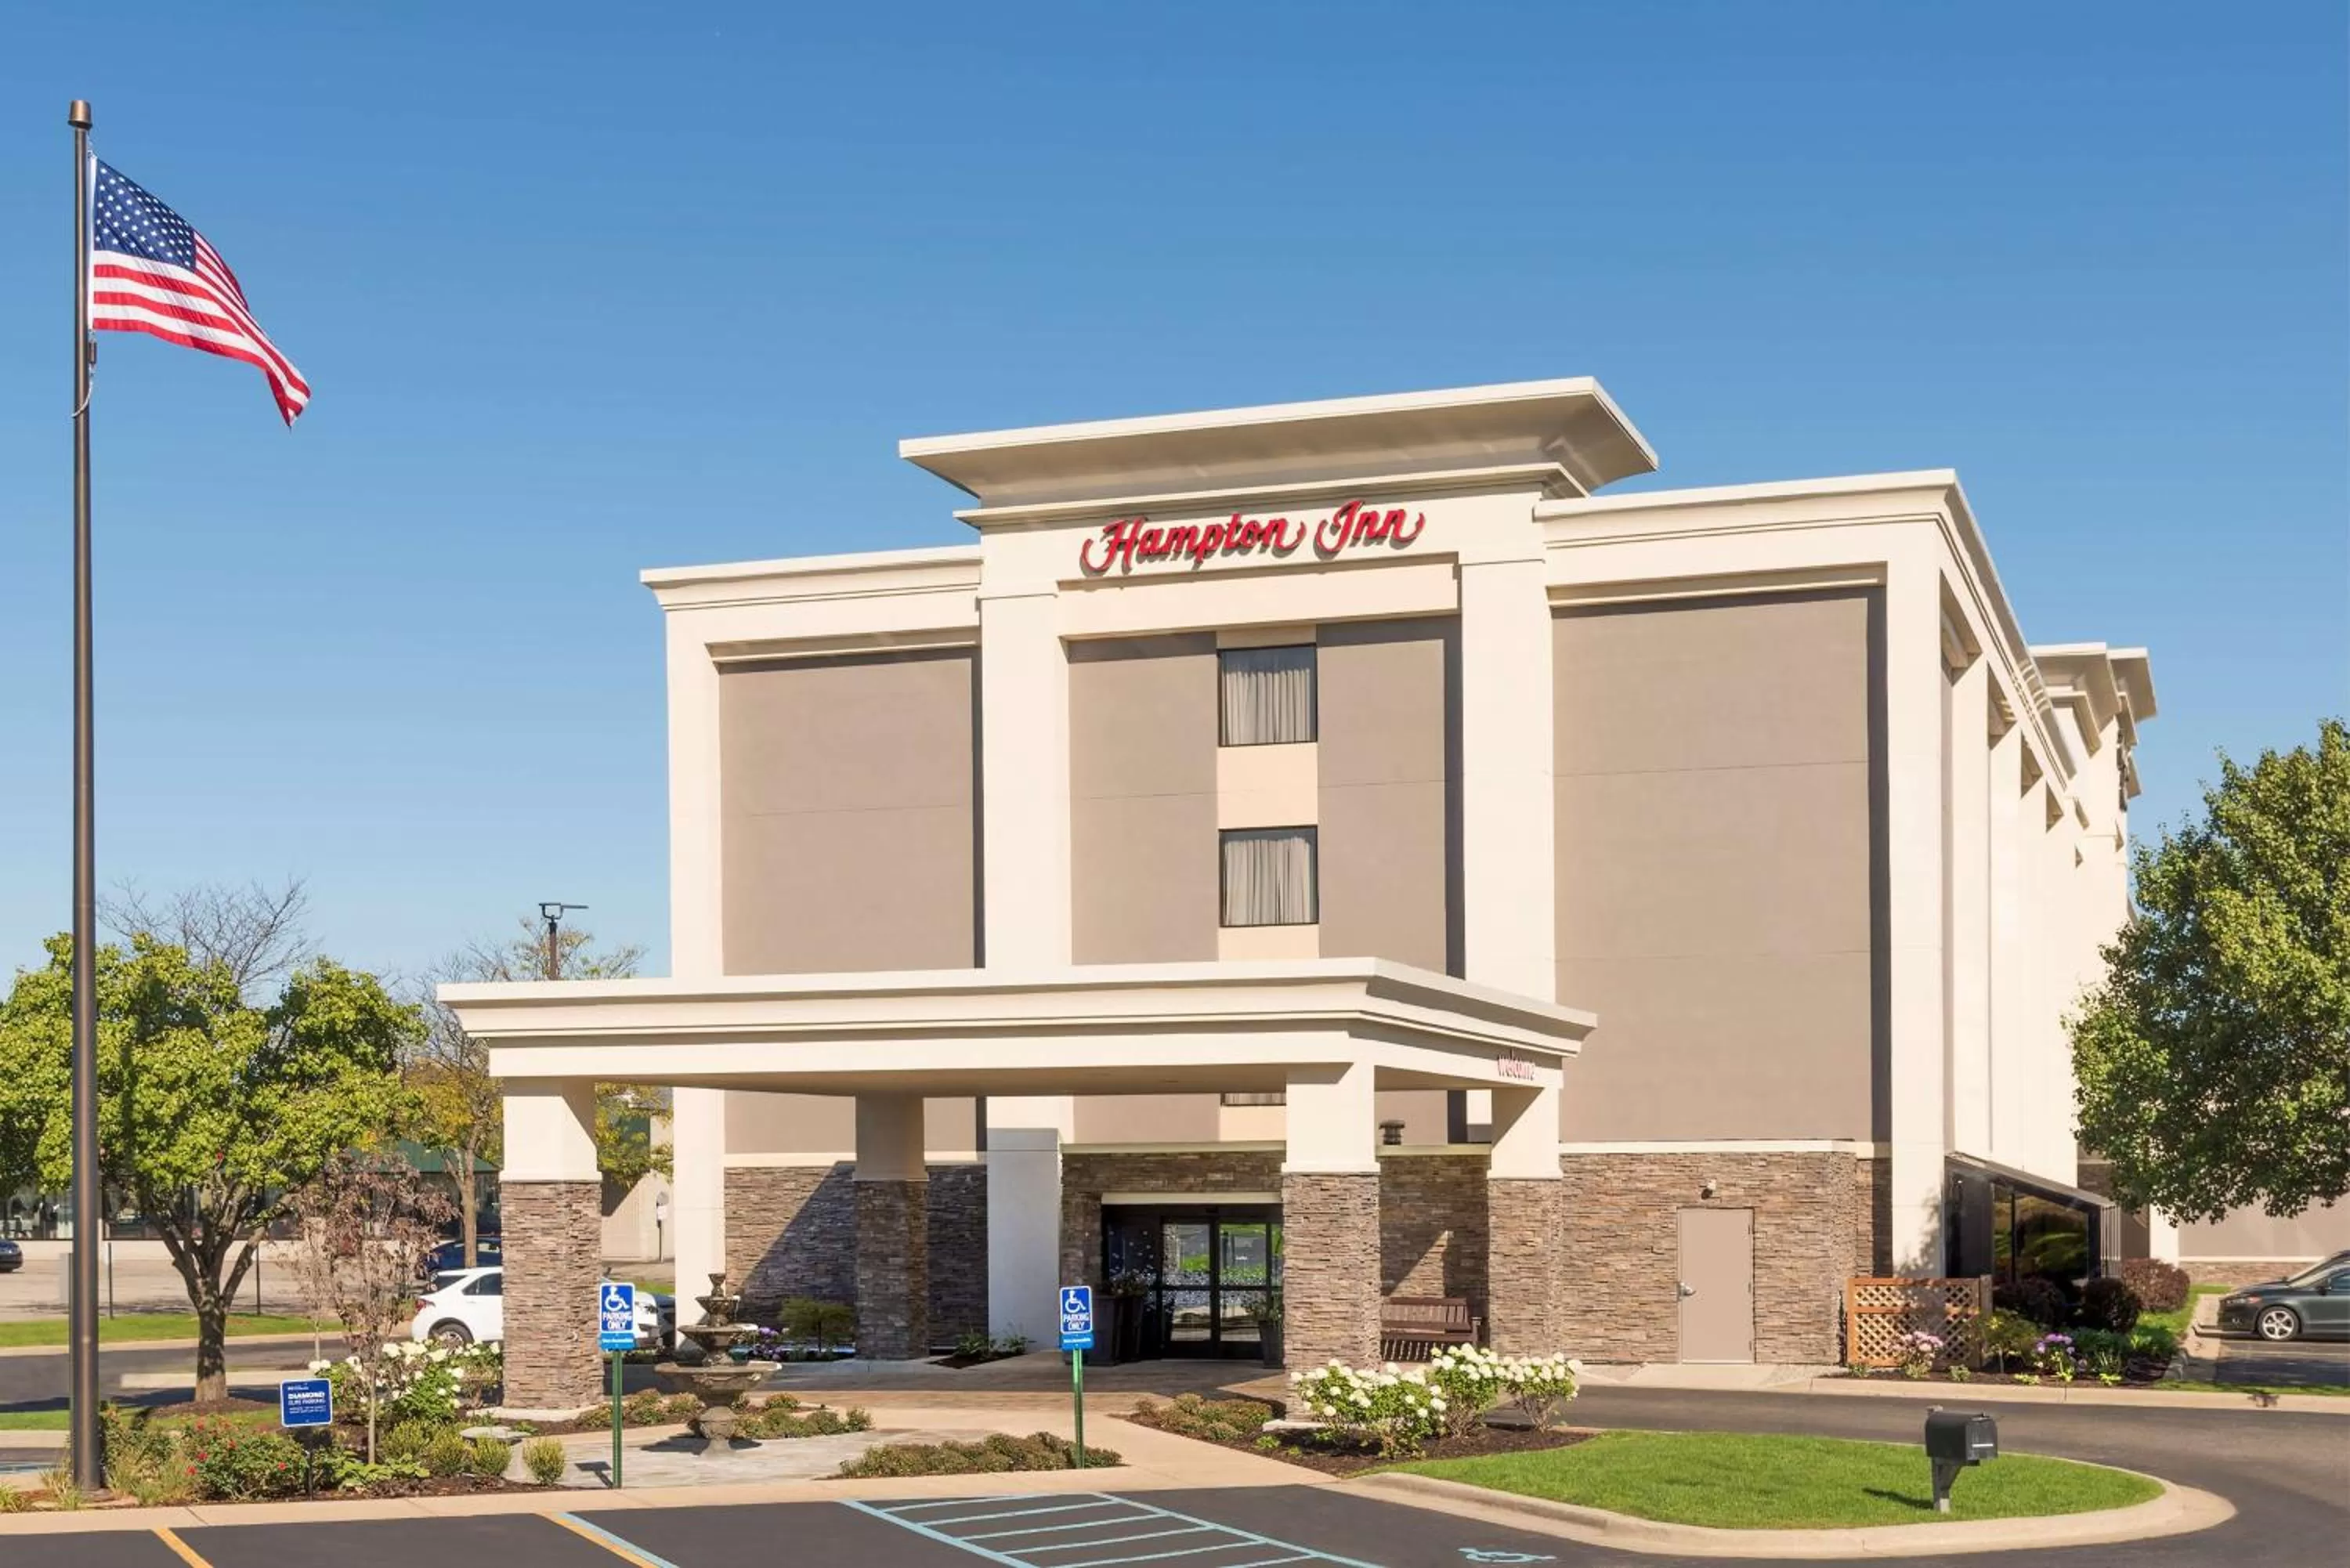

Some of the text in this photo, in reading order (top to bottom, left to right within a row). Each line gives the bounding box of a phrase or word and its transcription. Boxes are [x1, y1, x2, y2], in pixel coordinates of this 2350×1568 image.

[1081, 500, 1425, 573] Hampton Inn
[602, 1311, 632, 1321] PARKING
[1063, 1312, 1090, 1323] PARKING
[607, 1321, 627, 1330] ONLY
[1068, 1321, 1086, 1331] ONLY
[287, 1391, 325, 1400] DIAMOND
